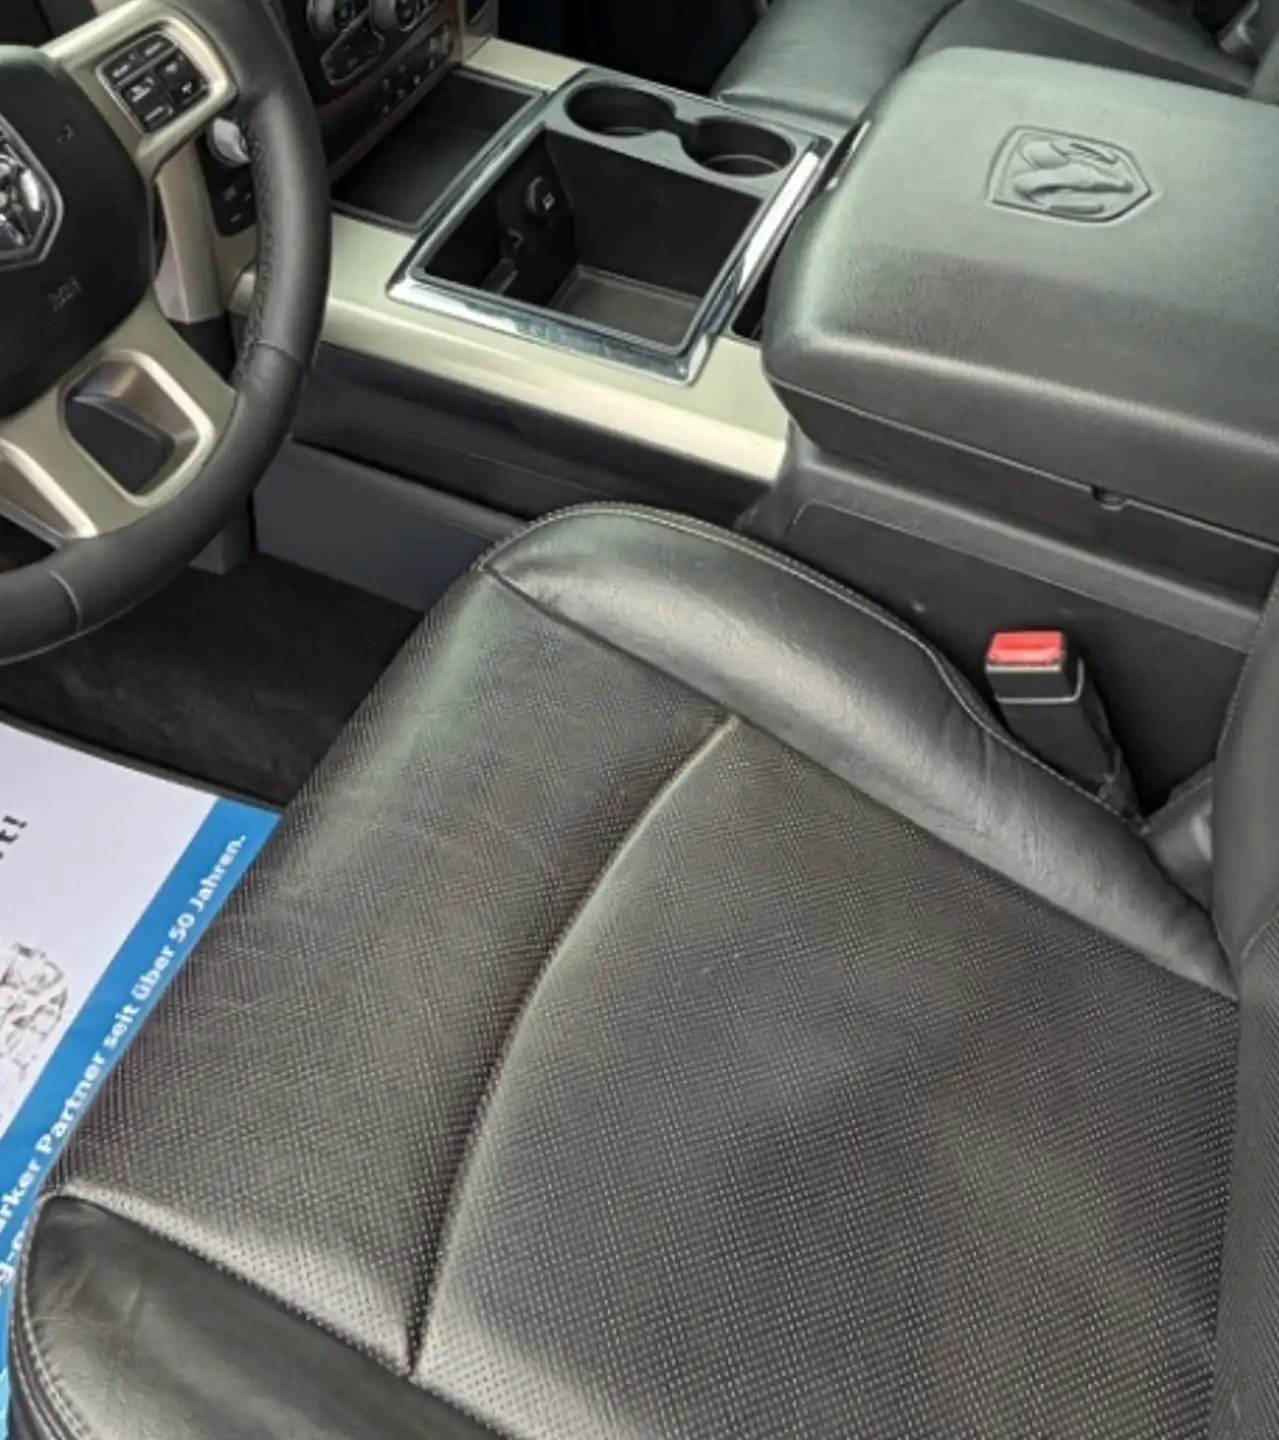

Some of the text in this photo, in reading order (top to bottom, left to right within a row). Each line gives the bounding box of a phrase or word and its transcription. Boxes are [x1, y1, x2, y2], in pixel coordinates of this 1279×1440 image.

[35, 1051, 107, 1155] Partner
[103, 1004, 141, 1050] seit
[130, 945, 175, 1003] über
[168, 911, 195, 942] 50
[188, 833, 248, 913] Jahren.
